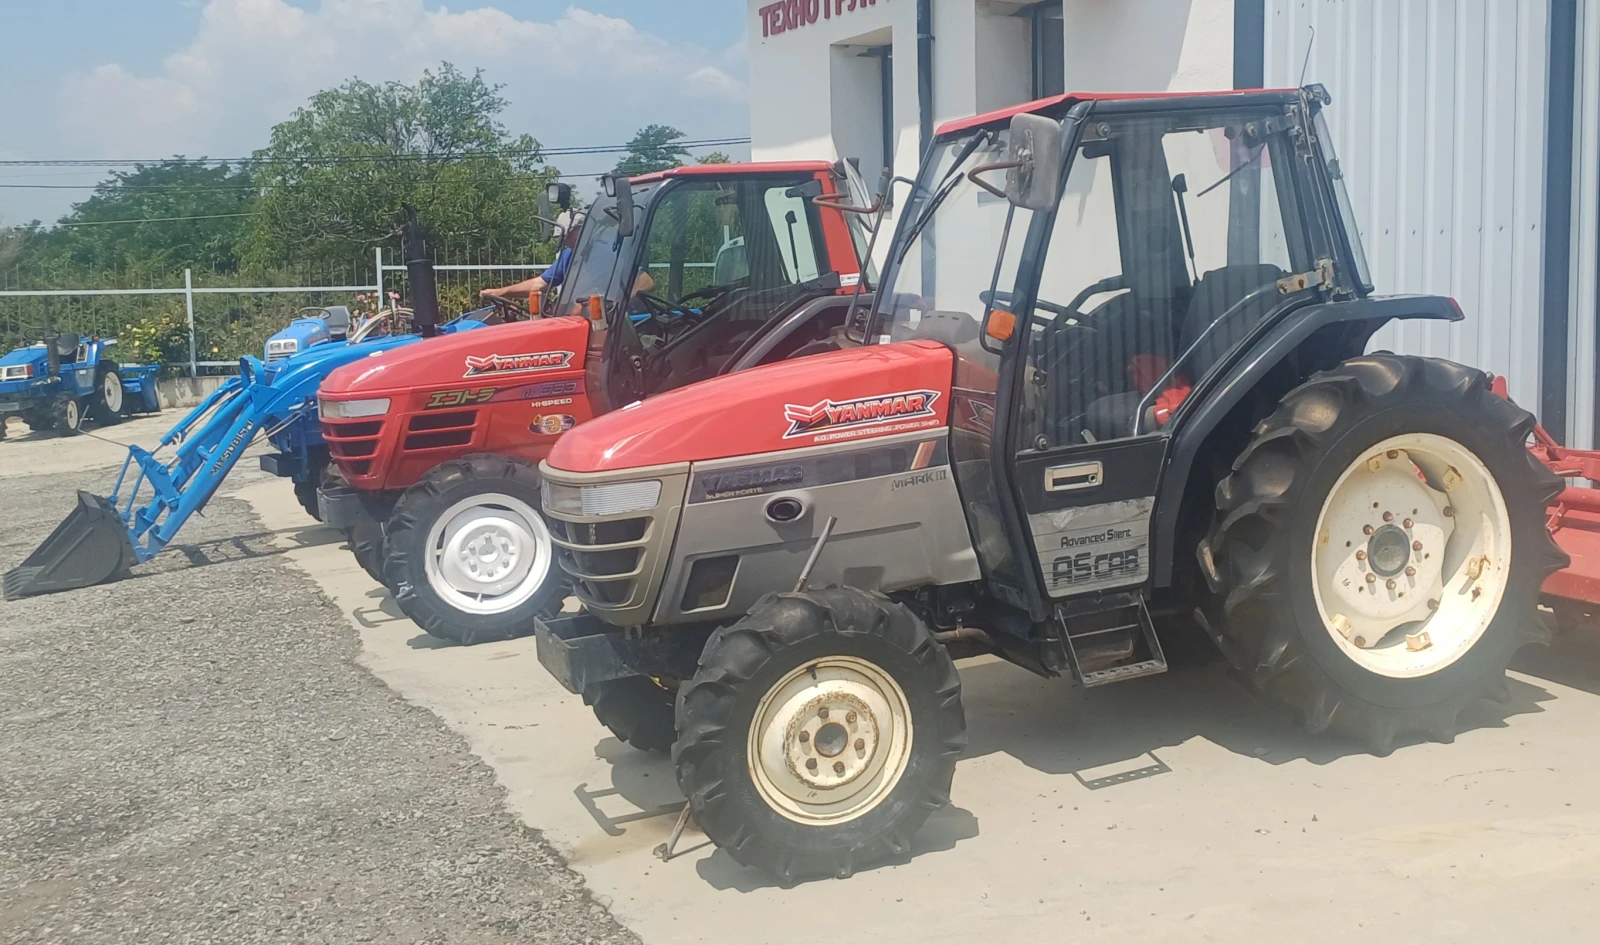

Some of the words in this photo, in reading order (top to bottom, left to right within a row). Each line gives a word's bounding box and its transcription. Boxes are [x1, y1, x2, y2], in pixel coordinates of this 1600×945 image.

[496, 354, 563, 371] YANMAR
[427, 388, 495, 407] エコトラ
[826, 394, 926, 424] YANMAR
[702, 464, 804, 493] YANMAR
[891, 472, 935, 492] MARK
[705, 491, 735, 500] SUPER
[1060, 532, 1106, 548] Advanced
[1106, 529, 1132, 541] Silent
